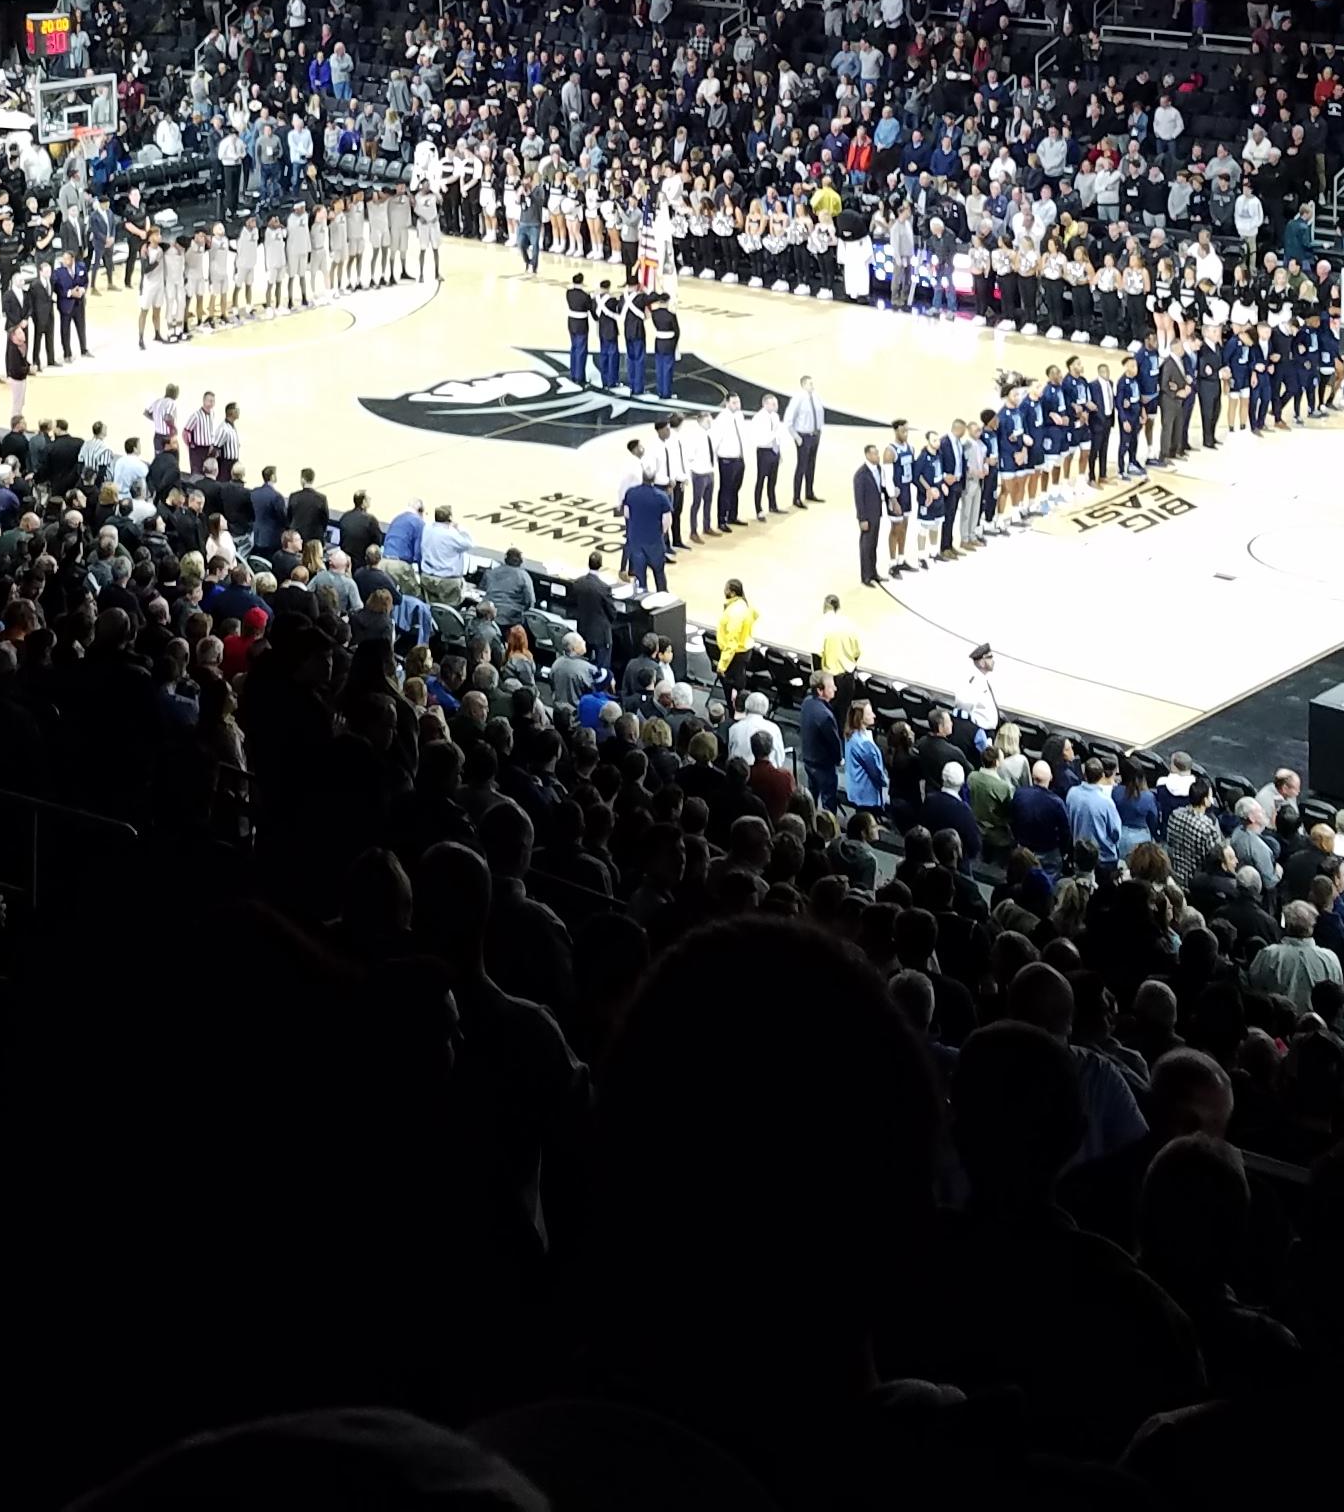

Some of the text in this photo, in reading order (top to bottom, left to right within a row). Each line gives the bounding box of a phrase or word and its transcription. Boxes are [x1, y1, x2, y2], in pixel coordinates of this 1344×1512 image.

[500, 500, 626, 538] ONUTS
[1071, 485, 1174, 533] EAST
[1118, 497, 1198, 533] BIG
